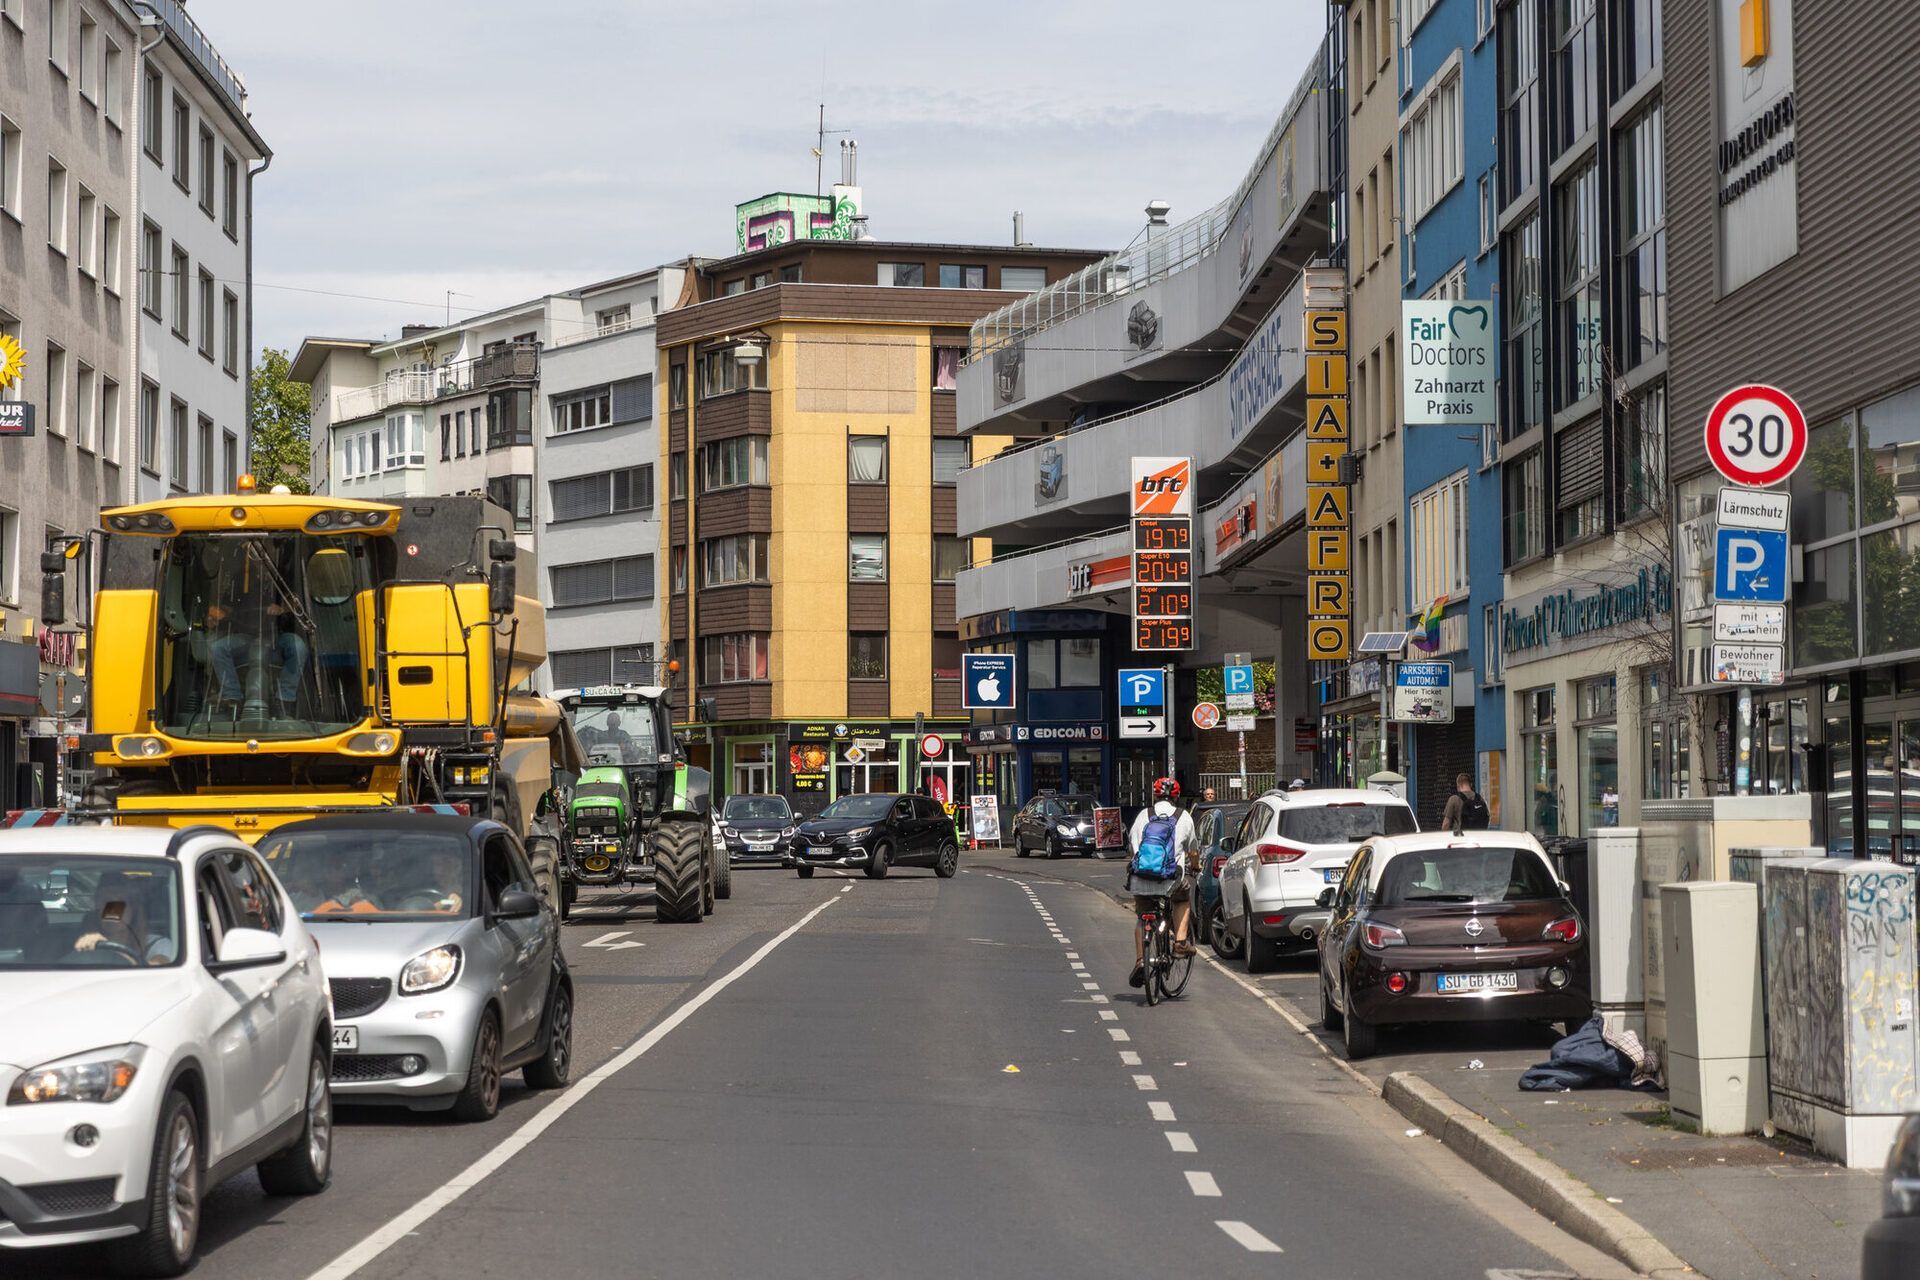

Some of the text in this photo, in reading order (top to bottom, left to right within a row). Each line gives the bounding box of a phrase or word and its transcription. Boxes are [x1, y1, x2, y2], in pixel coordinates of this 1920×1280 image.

[1411, 318, 1446, 341] Fair
[1411, 342, 1485, 366] Doctors
[1414, 378, 1485, 394] Zahnarzt
[1427, 400, 1474, 415] Praxis
[1727, 413, 1784, 459] 30
[1140, 475, 1183, 495] bft
[1723, 500, 1784, 519] Lärmschutz
[1726, 537, 1766, 592] P
[1071, 563, 1091, 590] bft
[1720, 649, 1775, 661] Bewohner
[1400, 665, 1448, 675] PARKSCHEIN-
[1738, 667, 1757, 678] frei
[1231, 669, 1247, 691] P
[1406, 676, 1440, 686] AUTOMAT
[1134, 680, 1152, 703] P
[1420, 688, 1442, 696] Ticket
[1136, 707, 1148, 716] frei
[1033, 728, 1087, 739] EDICOM
[1330, 870, 1341, 880] BN
[1446, 974, 1516, 988] SU GB 1430
